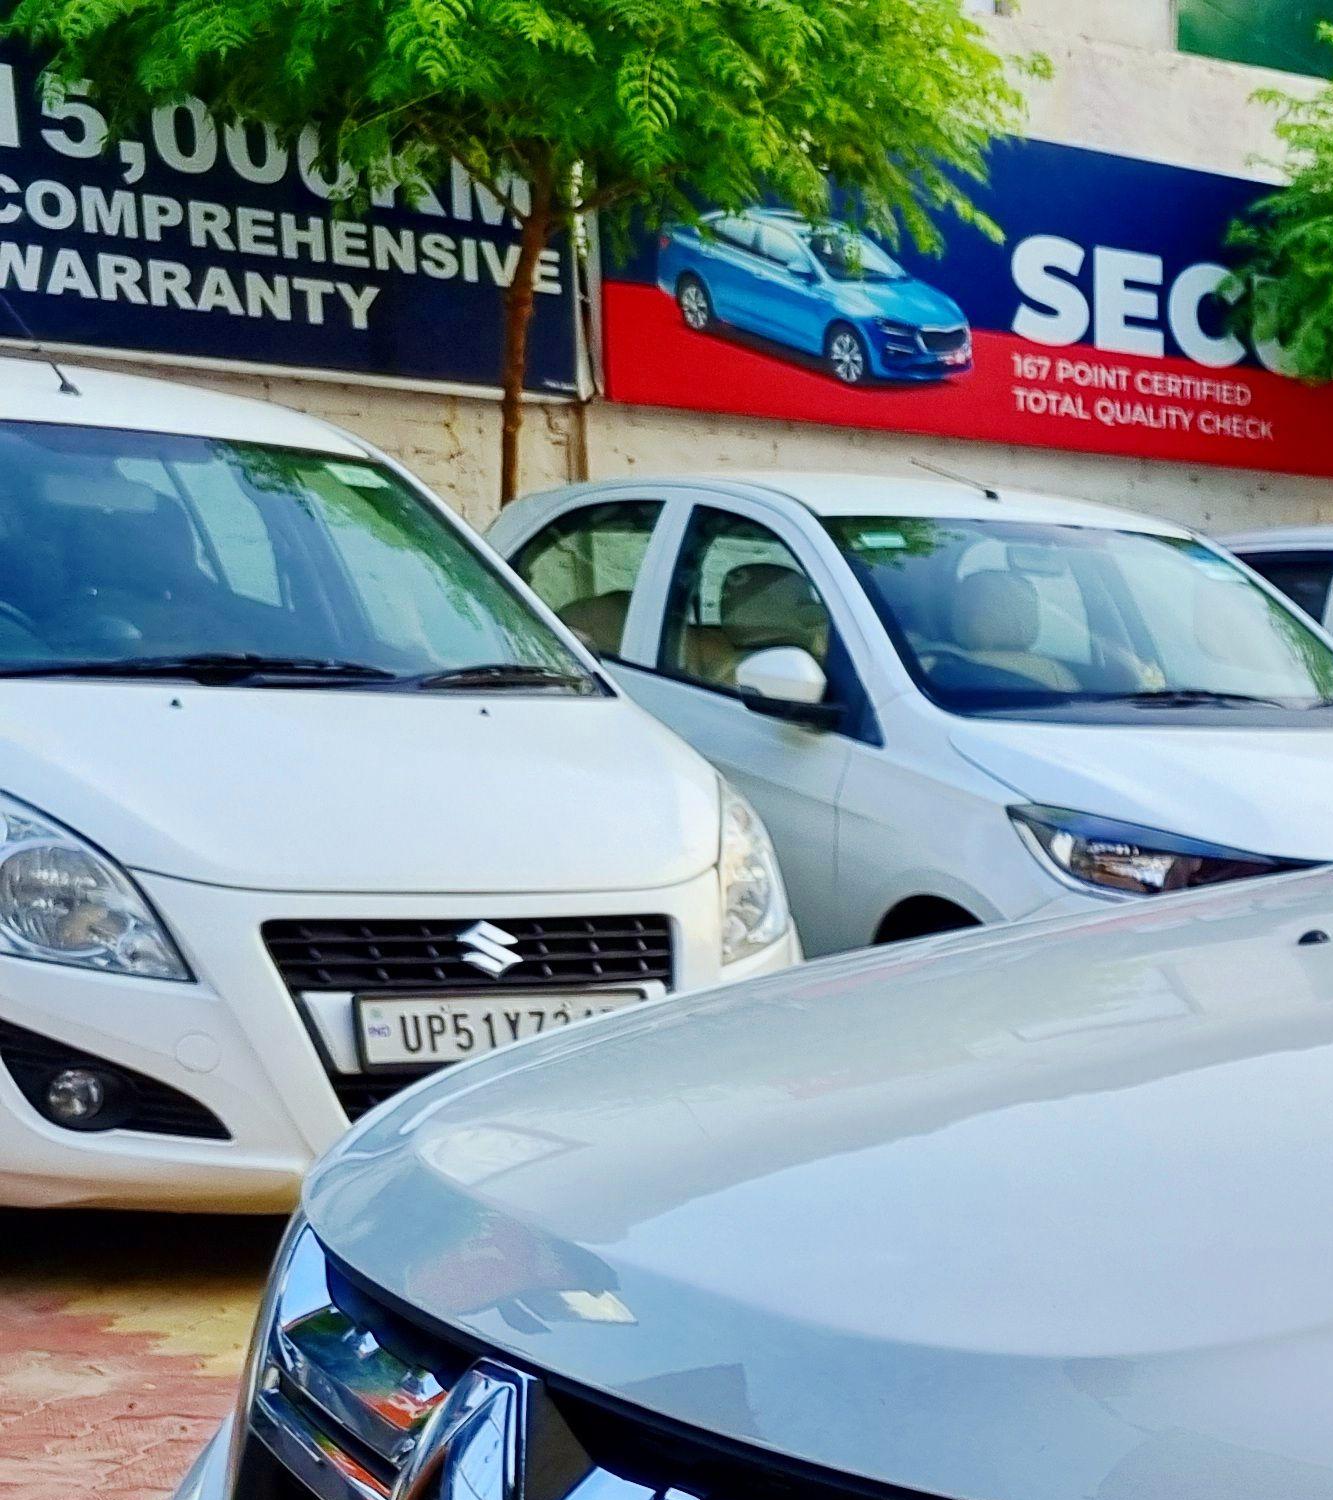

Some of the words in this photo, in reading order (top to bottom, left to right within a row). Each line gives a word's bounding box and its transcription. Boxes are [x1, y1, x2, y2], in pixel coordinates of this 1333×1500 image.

[0, 240, 380, 330] WARRANTY
[1011, 352, 1051, 381] 167
[1056, 359, 1132, 391] POINT
[1134, 370, 1252, 407] CERTIFIED
[1011, 386, 1091, 421] TOTAL
[1094, 397, 1195, 431] QUALITY
[1199, 411, 1275, 441] CHECK
